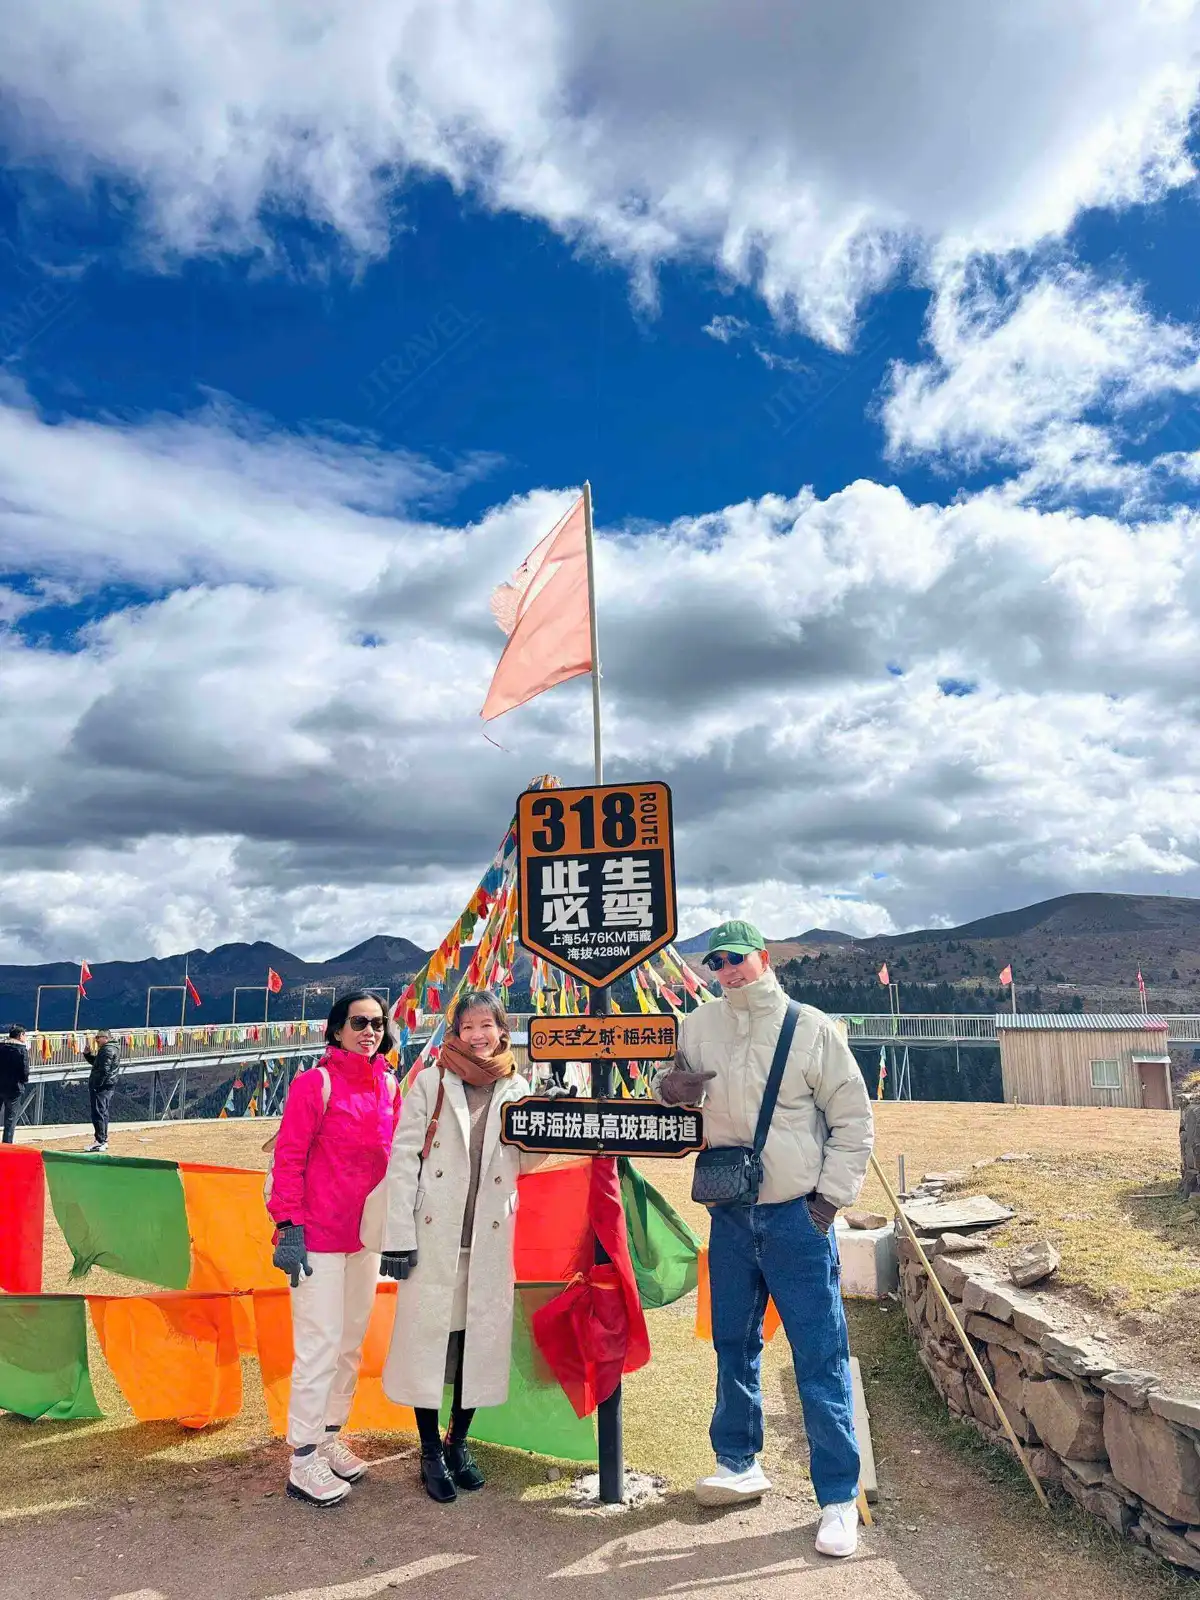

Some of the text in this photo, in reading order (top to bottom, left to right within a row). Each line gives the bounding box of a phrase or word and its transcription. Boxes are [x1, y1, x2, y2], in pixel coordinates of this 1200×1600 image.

[531, 792, 637, 852] 318
[639, 792, 658, 845] ROUTE
[541, 857, 652, 896] 此生
[542, 892, 653, 932] 必驾
[550, 930, 652, 946] 上海5476KM西藏
[567, 945, 630, 960] 海拔4288M
[511, 1111, 697, 1142] 世界海拔最高玻璃栈道
